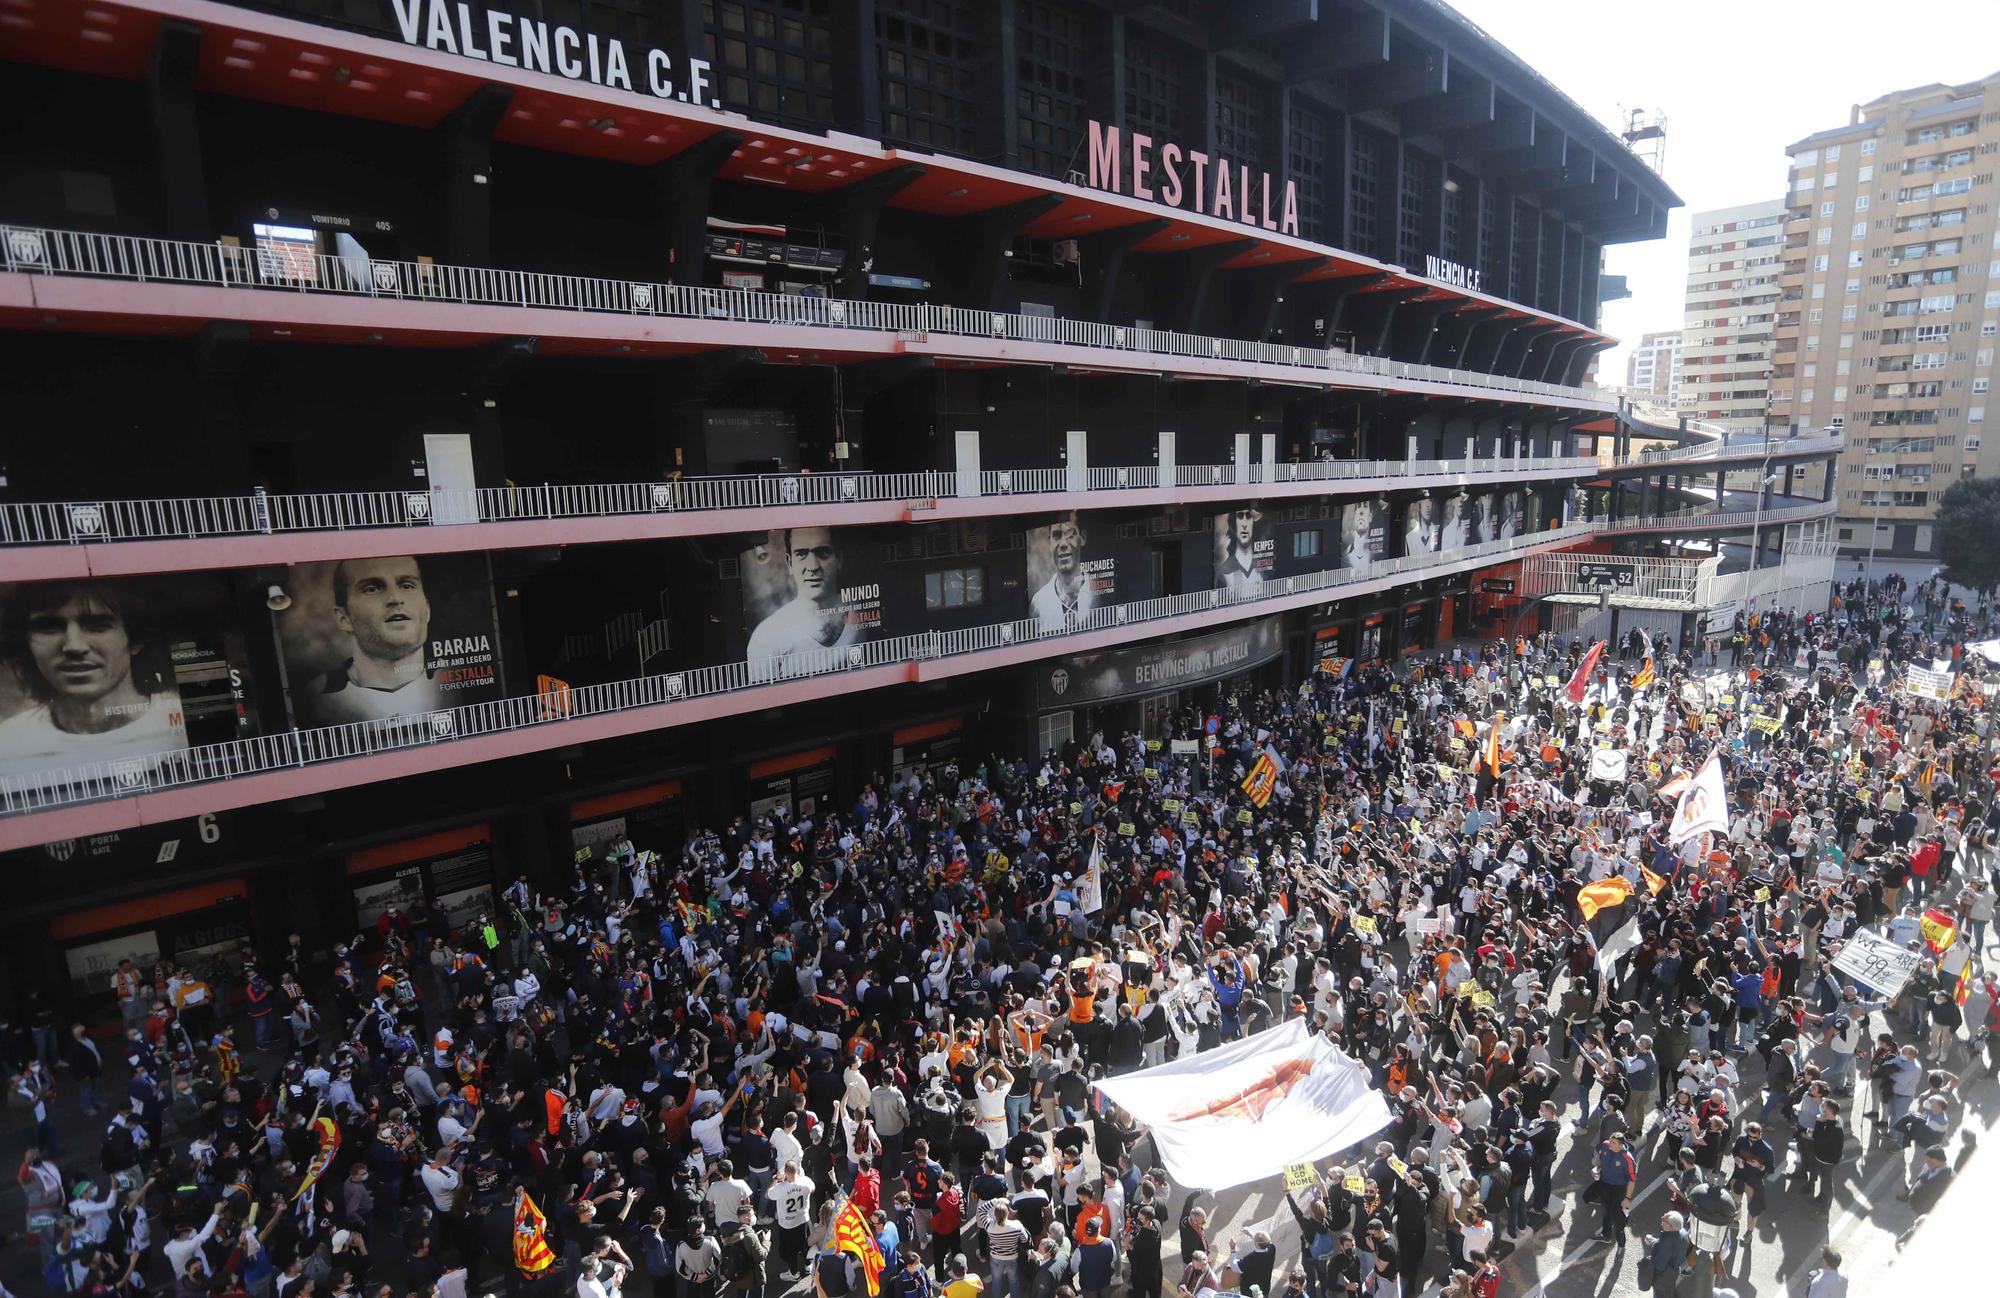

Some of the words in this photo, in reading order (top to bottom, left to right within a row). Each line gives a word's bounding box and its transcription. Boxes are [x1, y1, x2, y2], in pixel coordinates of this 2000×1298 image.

[391, 0, 632, 91] VALENCIA
[648, 48, 721, 109] C.F.
[1089, 119, 1299, 237] MESTALLA
[312, 214, 351, 226] VOMITORIO
[375, 220, 391, 231] 405
[1426, 254, 1465, 287] VALENCIA
[1467, 267, 1481, 292] C.F.
[1253, 540, 1274, 552] KEMPES
[1080, 558, 1115, 572] PUCHADES
[1618, 572, 1632, 584] 52
[840, 583, 880, 603] MUNDO
[432, 634, 491, 658] BARAJA
[427, 659, 450, 670] HEART
[451, 656, 466, 667] AND
[466, 653, 492, 664] LEGEND
[1135, 658, 1203, 684] BENVINGUTS
[1204, 654, 1211, 670] A
[1212, 642, 1249, 667] MESTALLA
[439, 665, 495, 682] MESTALLA
[439, 677, 495, 692] FOREVERTOUR
[198, 813, 220, 844] 6
[90, 833, 121, 846] PORTA
[92, 845, 113, 856] GATE
[1858, 932, 1880, 953] WE
[1895, 953, 1918, 970] ARE
[1290, 1163, 1305, 1173] LIM
[1293, 1170, 1306, 1179] GO
[1289, 1176, 1313, 1187] HOME
[785, 1195, 804, 1214] 21
